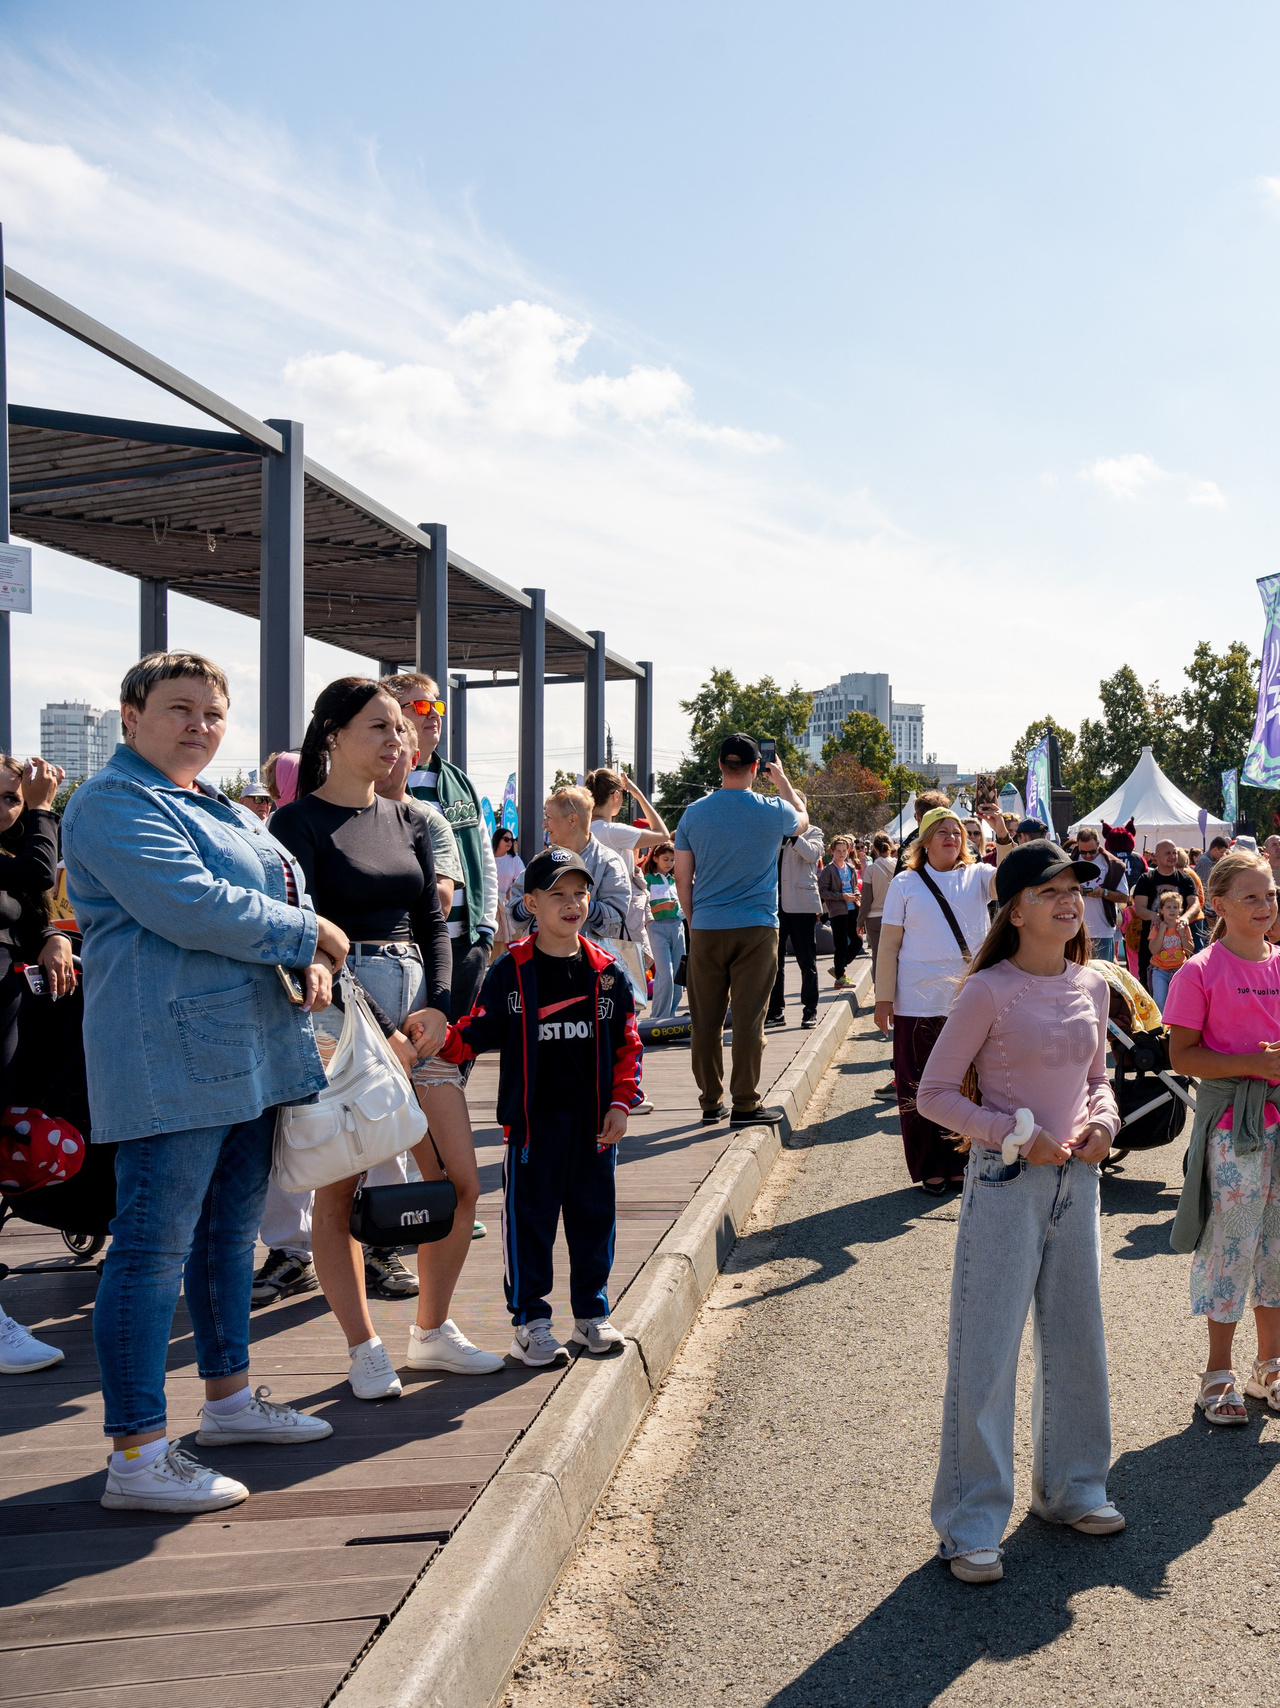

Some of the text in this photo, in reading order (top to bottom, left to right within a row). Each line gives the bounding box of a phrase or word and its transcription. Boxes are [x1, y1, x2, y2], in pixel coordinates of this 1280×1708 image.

[564, 1021, 589, 1039] DO
[662, 1025, 685, 1036] BODY
[1039, 1018, 1093, 1070] 58
